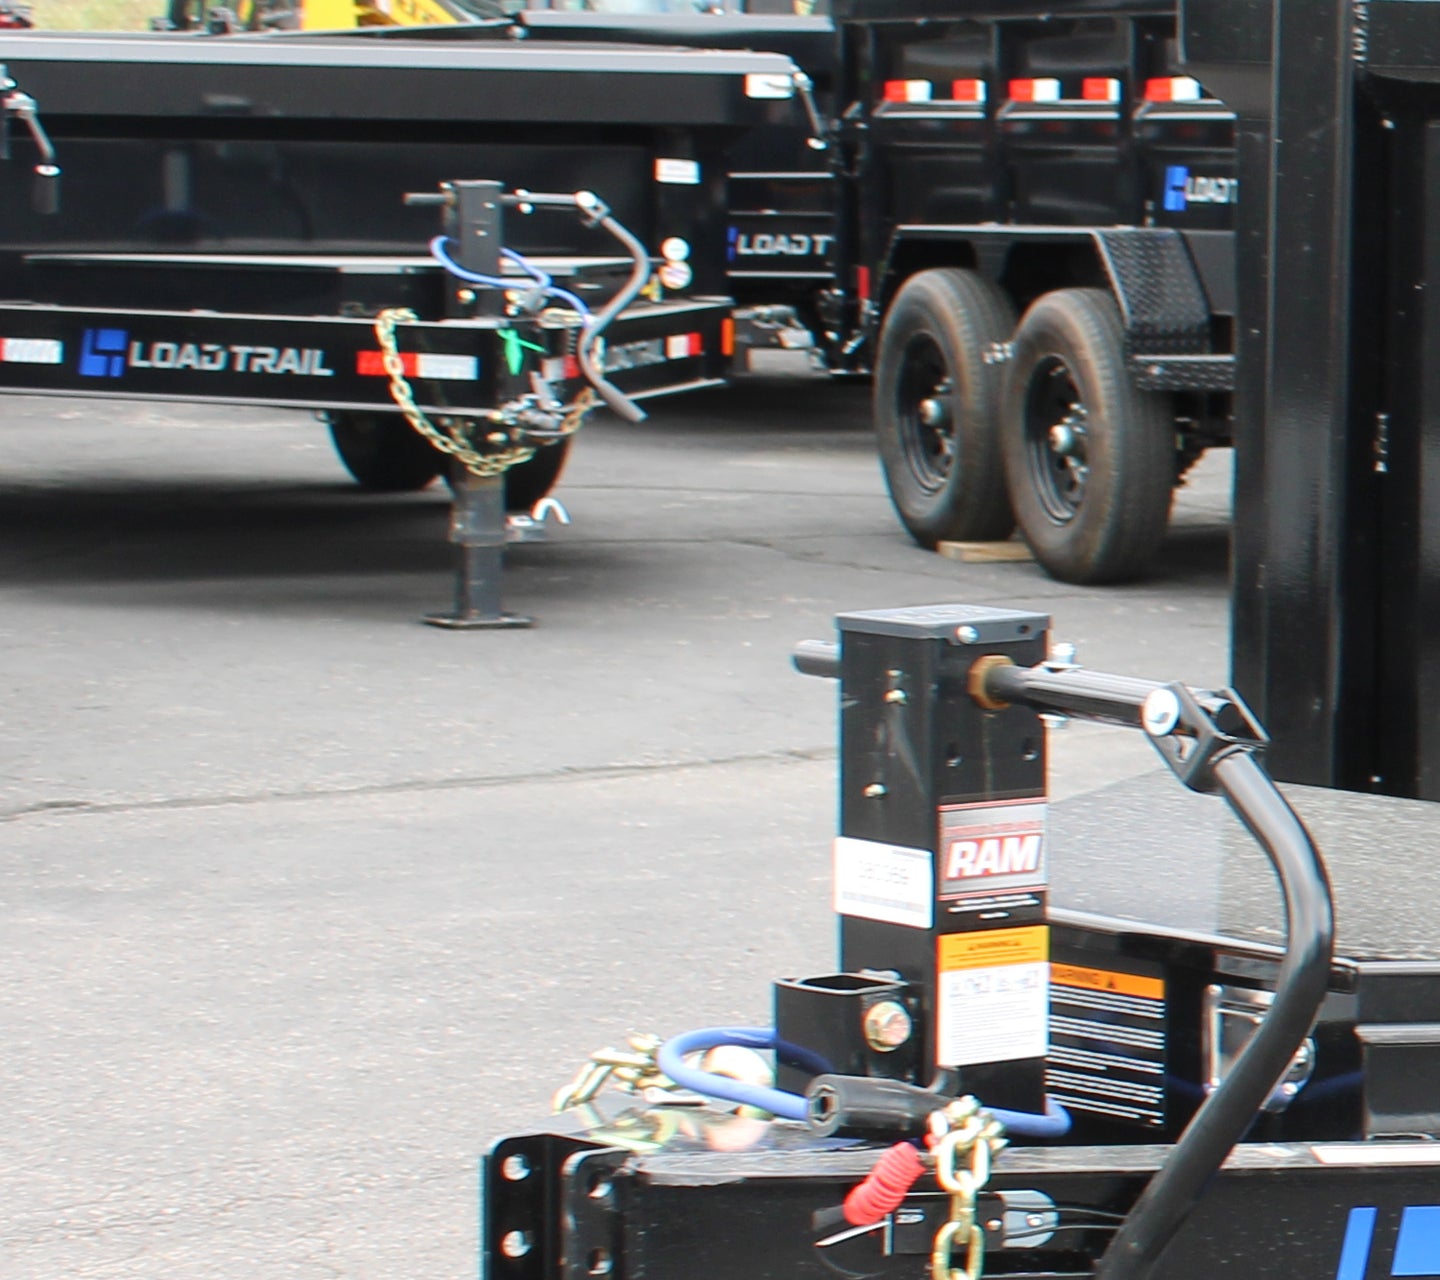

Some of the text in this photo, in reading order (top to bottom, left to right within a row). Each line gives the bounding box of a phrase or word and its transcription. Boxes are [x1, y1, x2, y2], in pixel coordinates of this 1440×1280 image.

[736, 234, 812, 255] LOAD
[129, 340, 336, 377] LOAD TRAIL
[945, 834, 1043, 880] RAM
